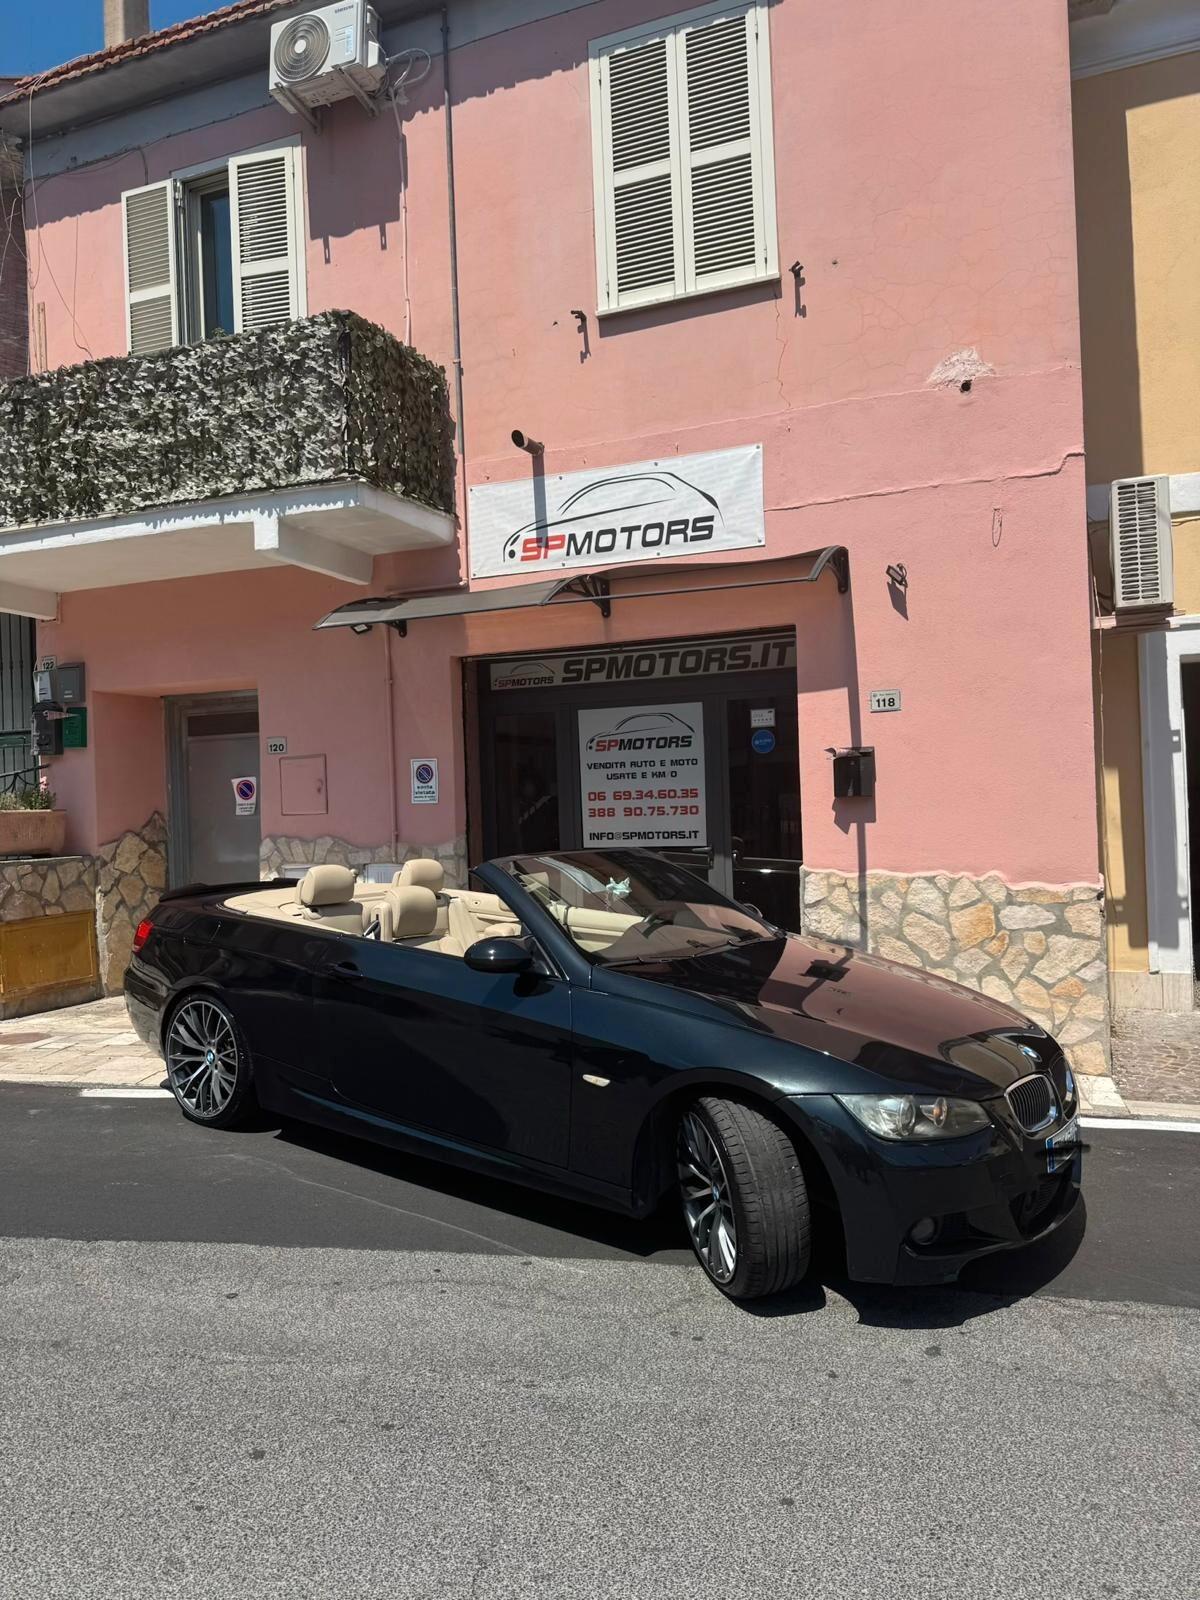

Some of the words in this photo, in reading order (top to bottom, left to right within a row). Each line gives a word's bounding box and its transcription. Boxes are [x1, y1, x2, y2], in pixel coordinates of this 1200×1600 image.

[520, 515, 715, 561] SPMOTORS
[562, 641, 795, 683] SPMOTORS.IT
[498, 676, 554, 688] SPMOTORS
[876, 697, 895, 707] 118
[269, 743, 285, 752] 120
[595, 735, 692, 752] SPMOTORS
[587, 761, 626, 770] VENDITA
[630, 760, 656, 769] AUTO
[660, 759, 666, 767] E
[671, 758, 698, 767] MOTO
[606, 772, 637, 781] USATE
[641, 771, 647, 779] E
[651, 771, 666, 779] KM
[588, 792, 606, 801] 06
[613, 788, 699, 801] 69.34.60.35
[588, 808, 615, 818] 388
[624, 805, 699, 817] 90.75.730
[589, 830, 699, 841] INFO@SPMOTORS.IT
